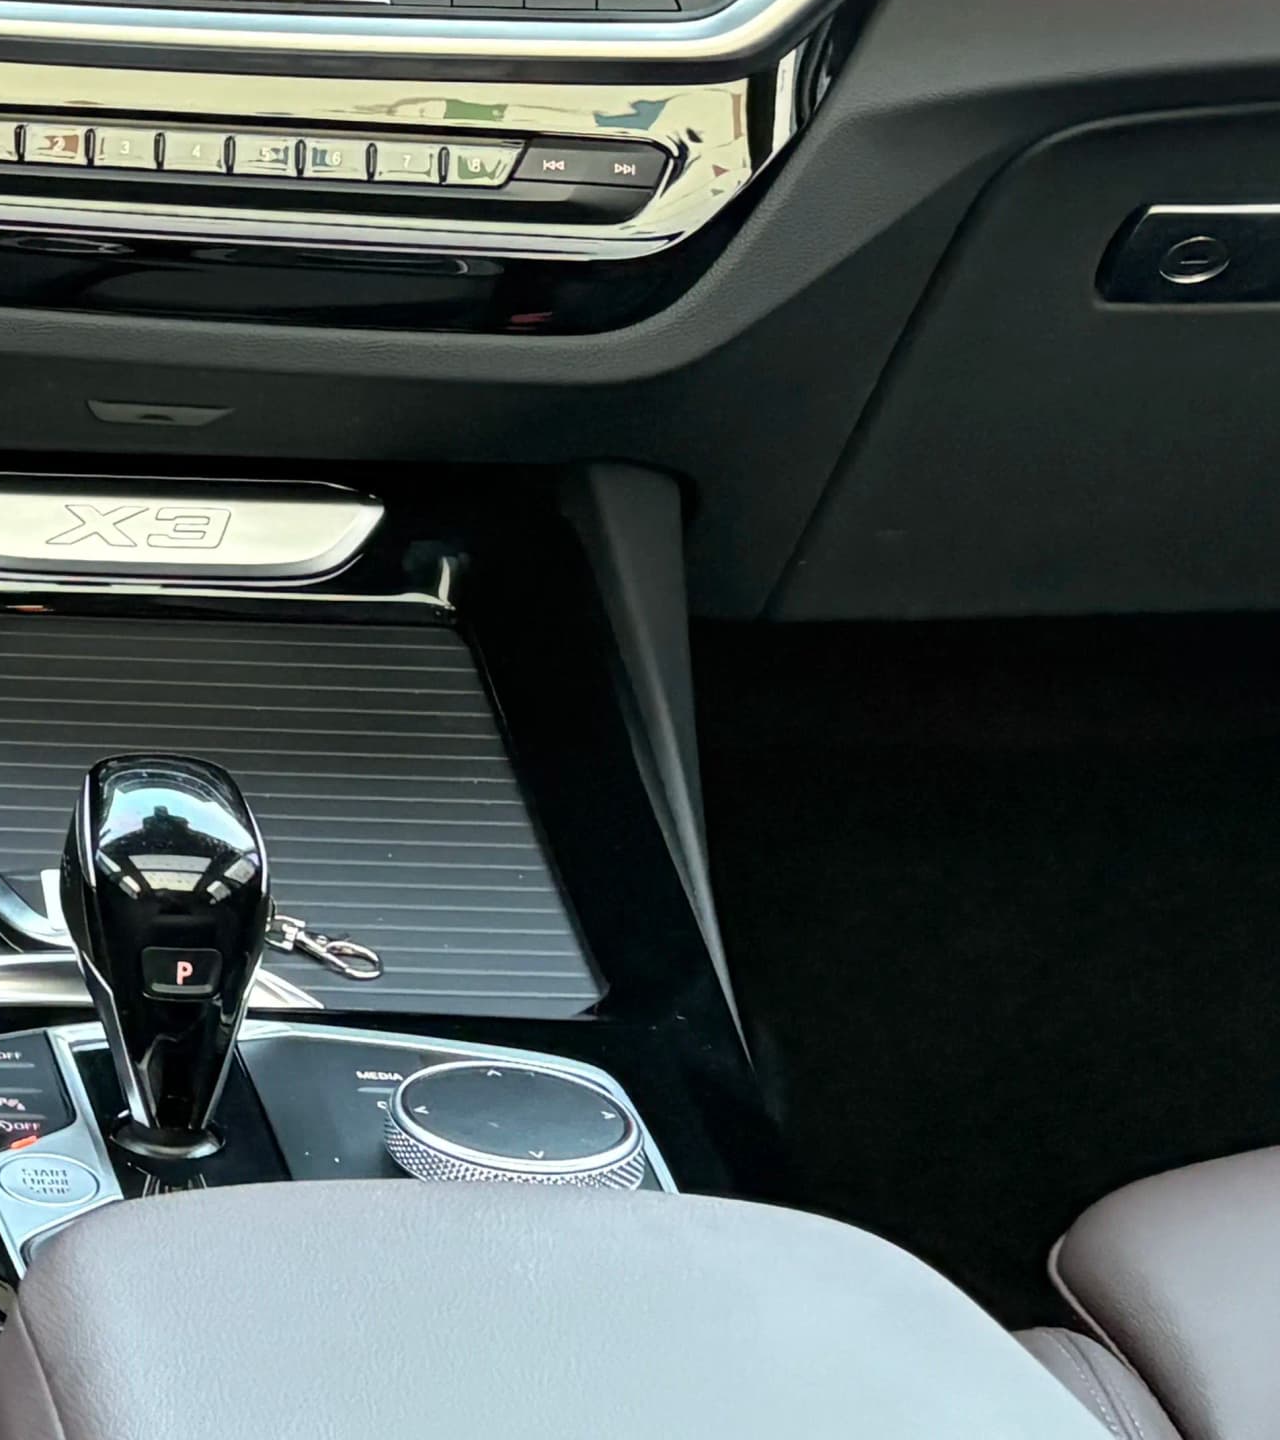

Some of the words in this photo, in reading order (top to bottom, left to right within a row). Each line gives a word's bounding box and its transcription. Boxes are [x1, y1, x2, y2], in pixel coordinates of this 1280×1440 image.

[45, 504, 232, 549] X3
[176, 960, 193, 986] P
[356, 1071, 403, 1081] MEDIA
